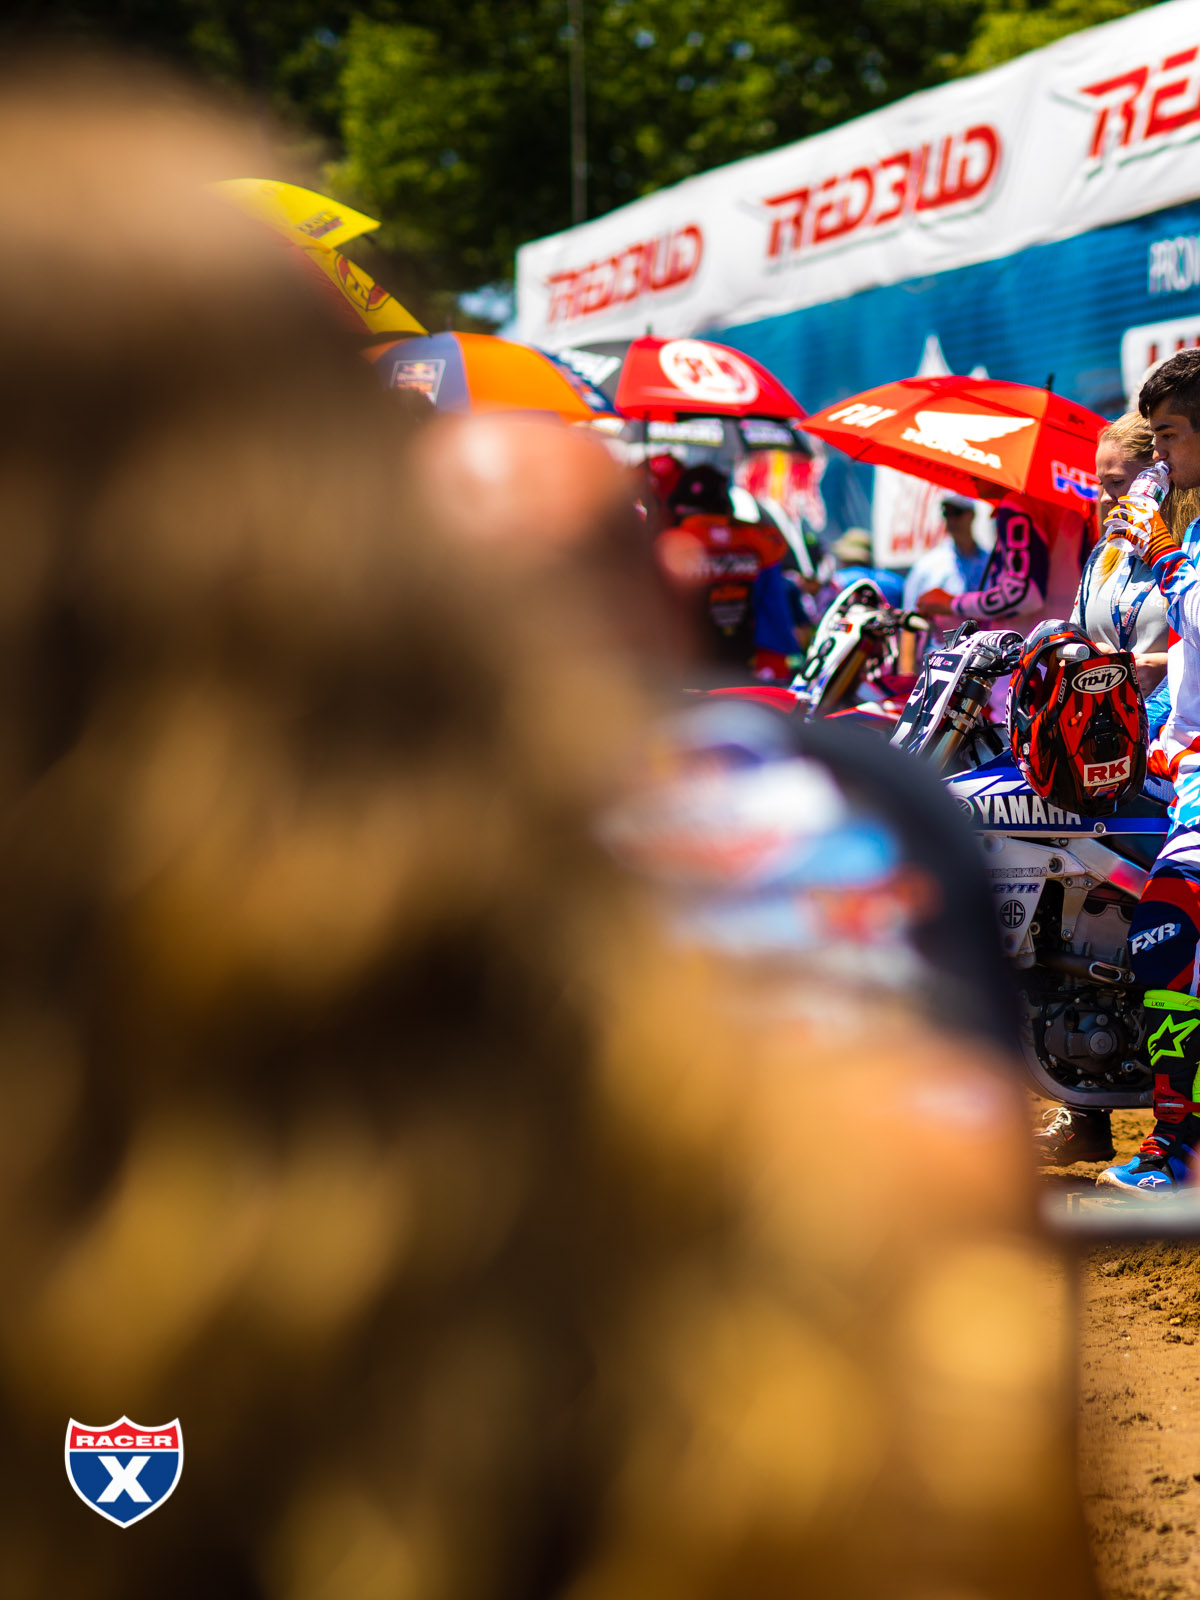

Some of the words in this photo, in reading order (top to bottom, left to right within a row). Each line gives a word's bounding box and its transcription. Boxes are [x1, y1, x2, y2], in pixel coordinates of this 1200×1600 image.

[763, 124, 1000, 258] REDBUD
[901, 427, 1002, 470] HONDA
[1080, 668, 1125, 690] Arai
[1087, 759, 1127, 781] RK
[993, 882, 1040, 894] GYTR
[1131, 922, 1176, 955] FXR
